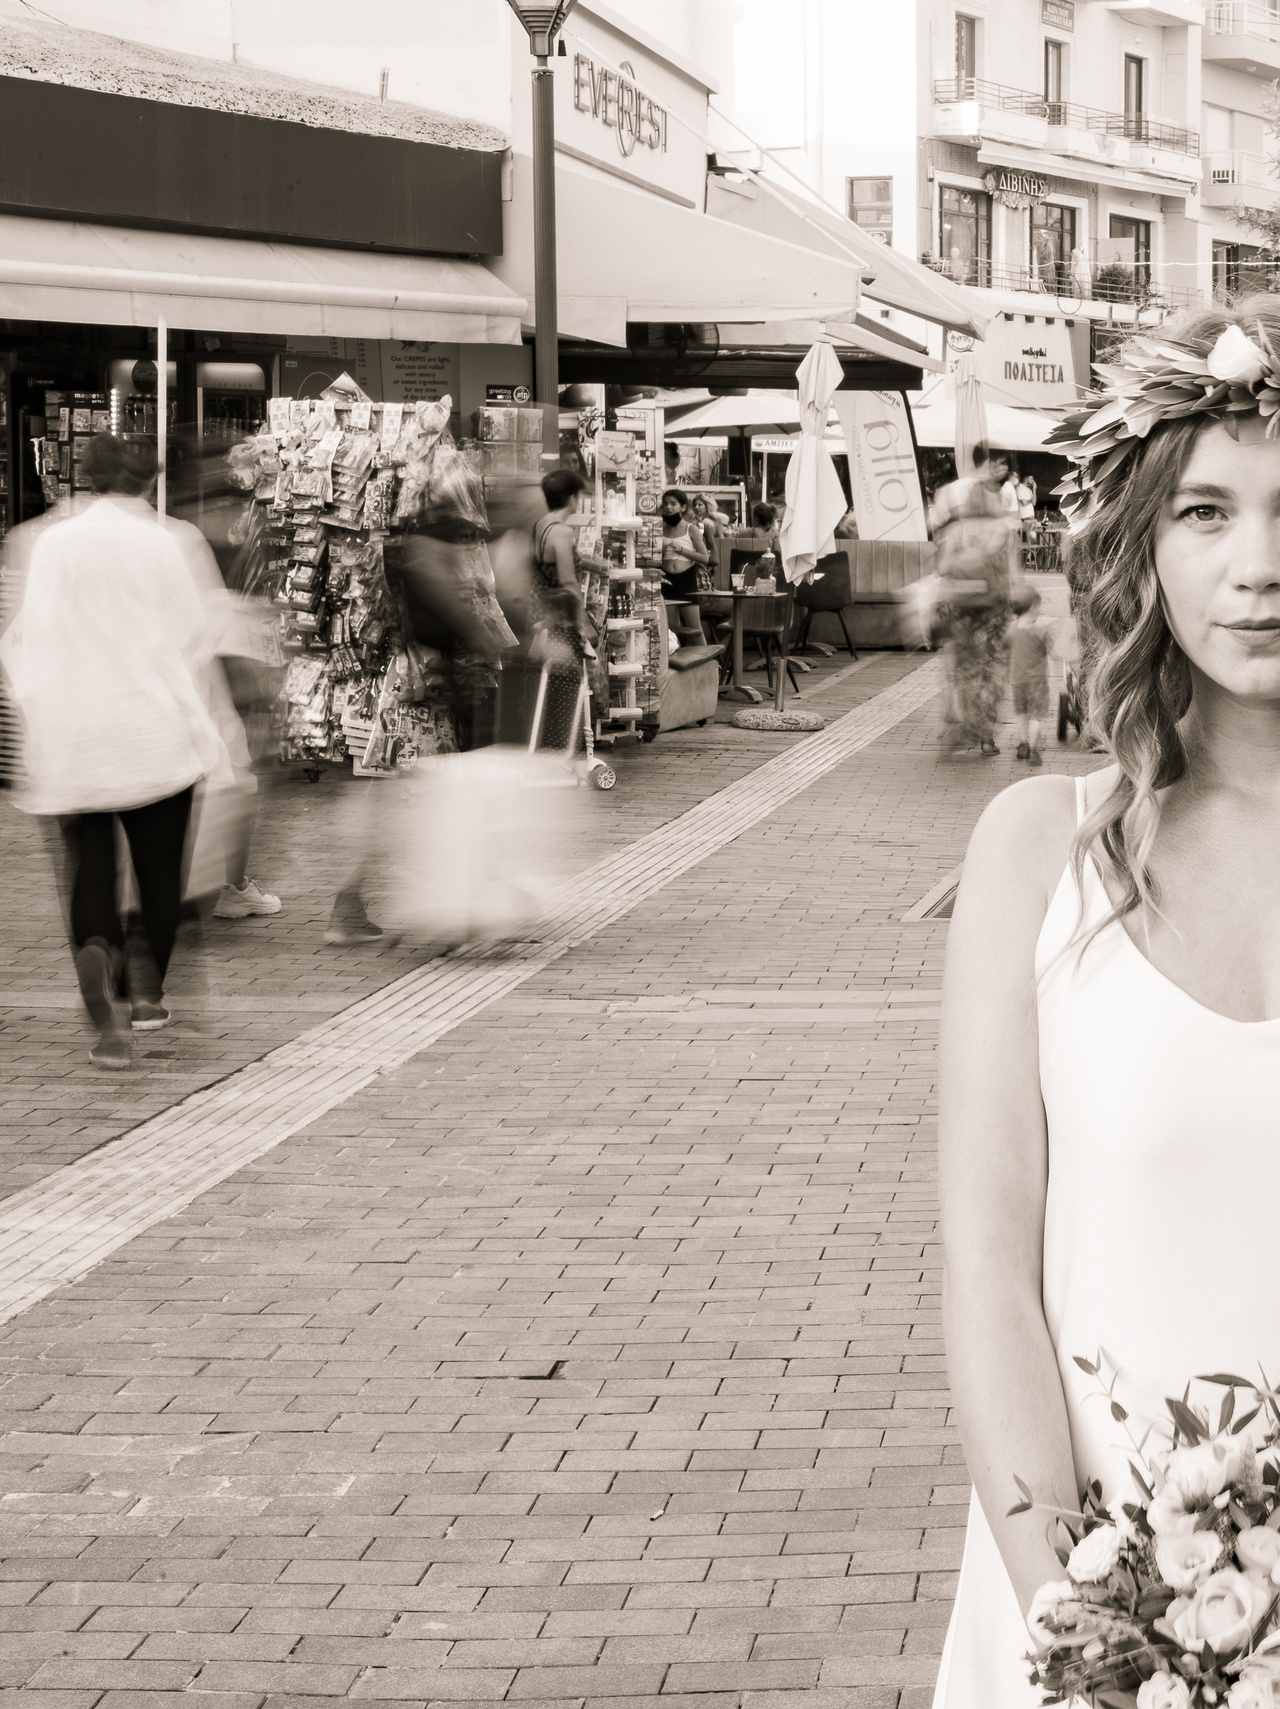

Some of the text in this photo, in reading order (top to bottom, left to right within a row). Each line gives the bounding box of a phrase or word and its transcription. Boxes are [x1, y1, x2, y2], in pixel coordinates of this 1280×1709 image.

[574, 52, 667, 156] EVEREST
[1000, 172, 1045, 197] ΔΙΒΙΝΗΣ
[1004, 361, 1064, 383] ΠΟΛΙΤΕΙΑ
